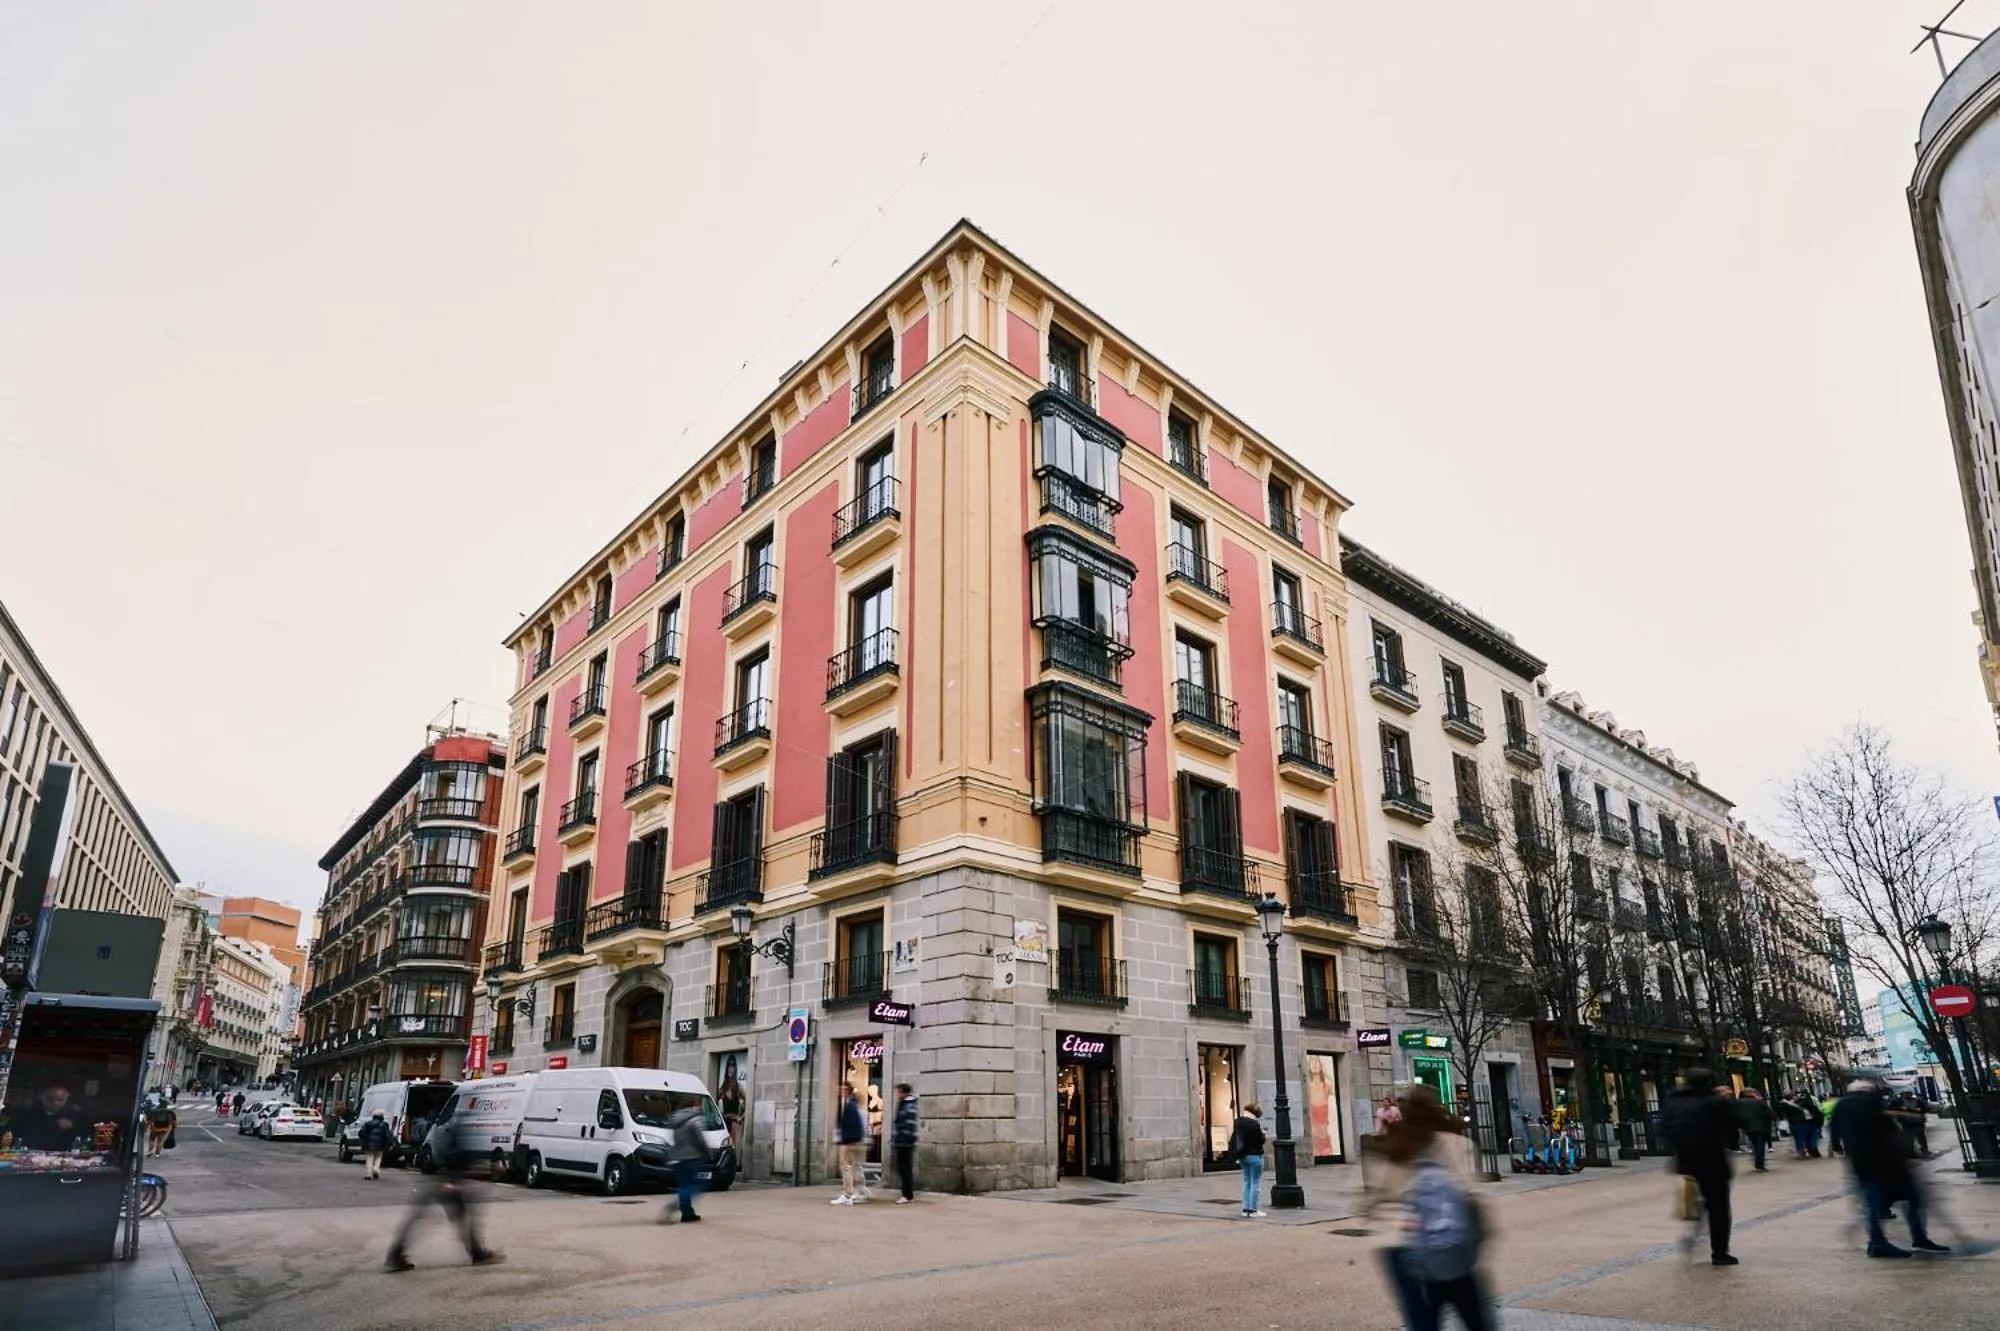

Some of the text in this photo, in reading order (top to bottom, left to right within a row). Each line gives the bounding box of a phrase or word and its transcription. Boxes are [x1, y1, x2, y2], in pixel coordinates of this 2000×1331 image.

[996, 951, 1014, 964] TOC
[1836, 965, 1861, 1025] MODERNO
[874, 1002, 908, 1018] Etam
[679, 1021, 692, 1031] TOC
[1062, 1034, 1105, 1053] Etam
[1359, 1031, 1389, 1042] Etam
